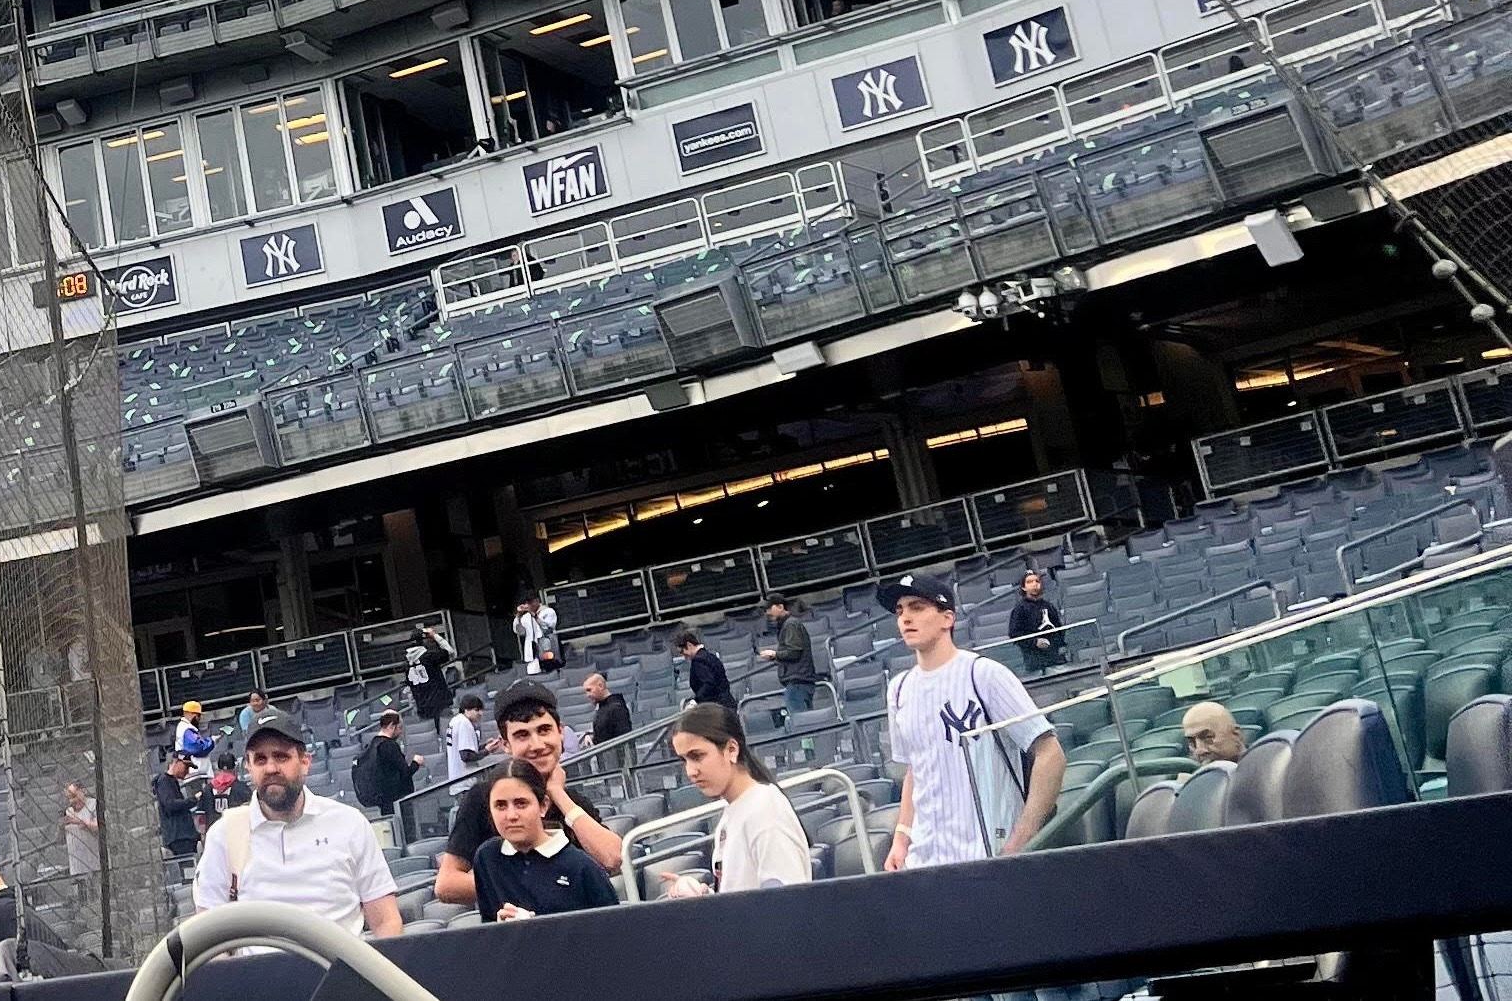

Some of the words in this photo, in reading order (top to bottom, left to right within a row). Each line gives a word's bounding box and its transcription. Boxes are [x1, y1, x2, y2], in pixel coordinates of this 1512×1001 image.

[683, 127, 753, 154] yankees.com
[531, 159, 597, 210] WFAN
[395, 224, 454, 249] Audacy
[137, 268, 171, 292] Rock
